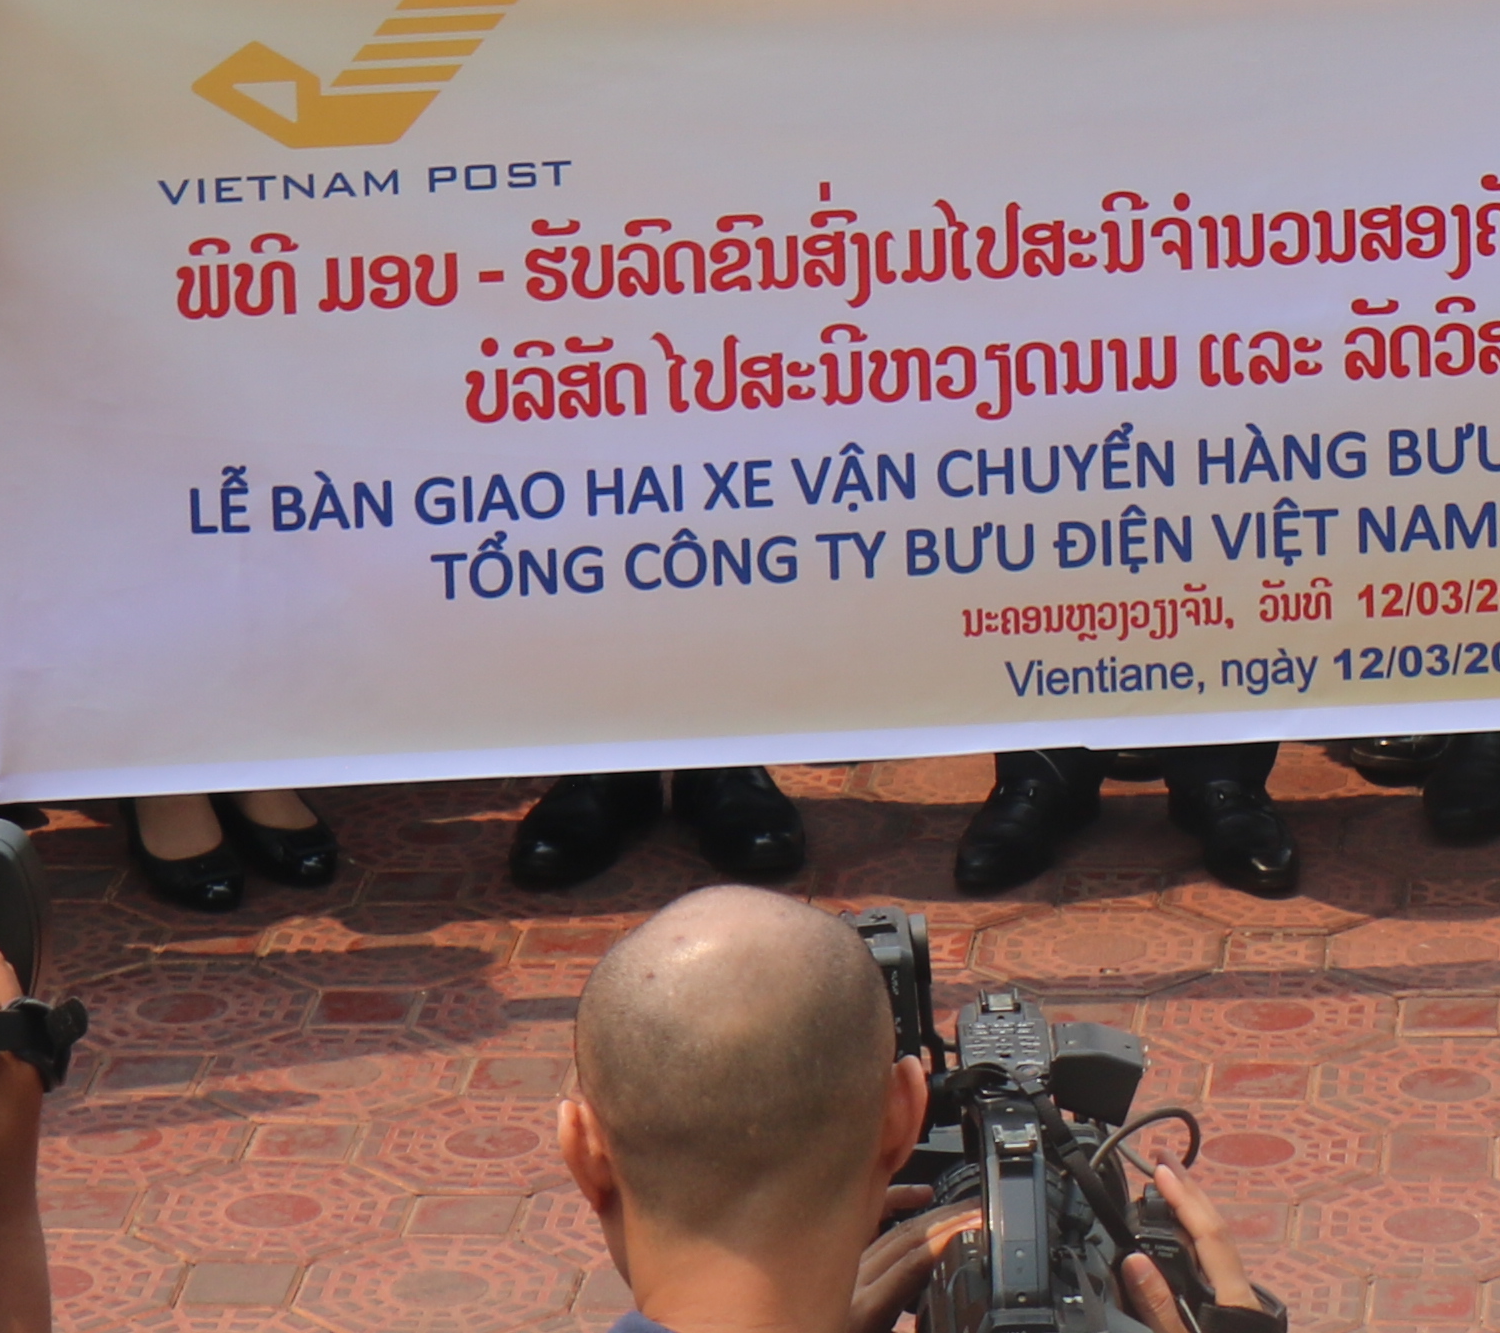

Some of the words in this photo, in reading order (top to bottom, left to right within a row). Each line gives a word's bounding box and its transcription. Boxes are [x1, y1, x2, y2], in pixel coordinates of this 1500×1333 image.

[158, 169, 399, 205] VIETNAM
[428, 160, 572, 193] POST
[177, 233, 297, 319] ພິທີ
[319, 253, 458, 311] ມອບ
[1200, 331, 1321, 386] ແລະ
[191, 467, 250, 534] LỄ
[273, 472, 393, 531] BÀN
[416, 472, 564, 525] GIAO
[588, 465, 683, 516] HAI
[704, 461, 773, 510] XE
[792, 443, 915, 512] VẬN
[939, 423, 1174, 497] CHUYỂN
[1200, 425, 1366, 485] HÀNG
[431, 531, 603, 599] TỔNG
[627, 529, 797, 590] CÔNG
[817, 533, 886, 580] TY
[908, 524, 1034, 576] BƯU
[1055, 506, 1192, 574] ĐIỆN
[1214, 499, 1339, 566] VIỆT
[1361, 503, 1497, 554] NAM
[1260, 577, 1332, 622] ວັນທີ
[1005, 656, 1204, 697] Vientiane,
[1221, 648, 1318, 695] ngày
